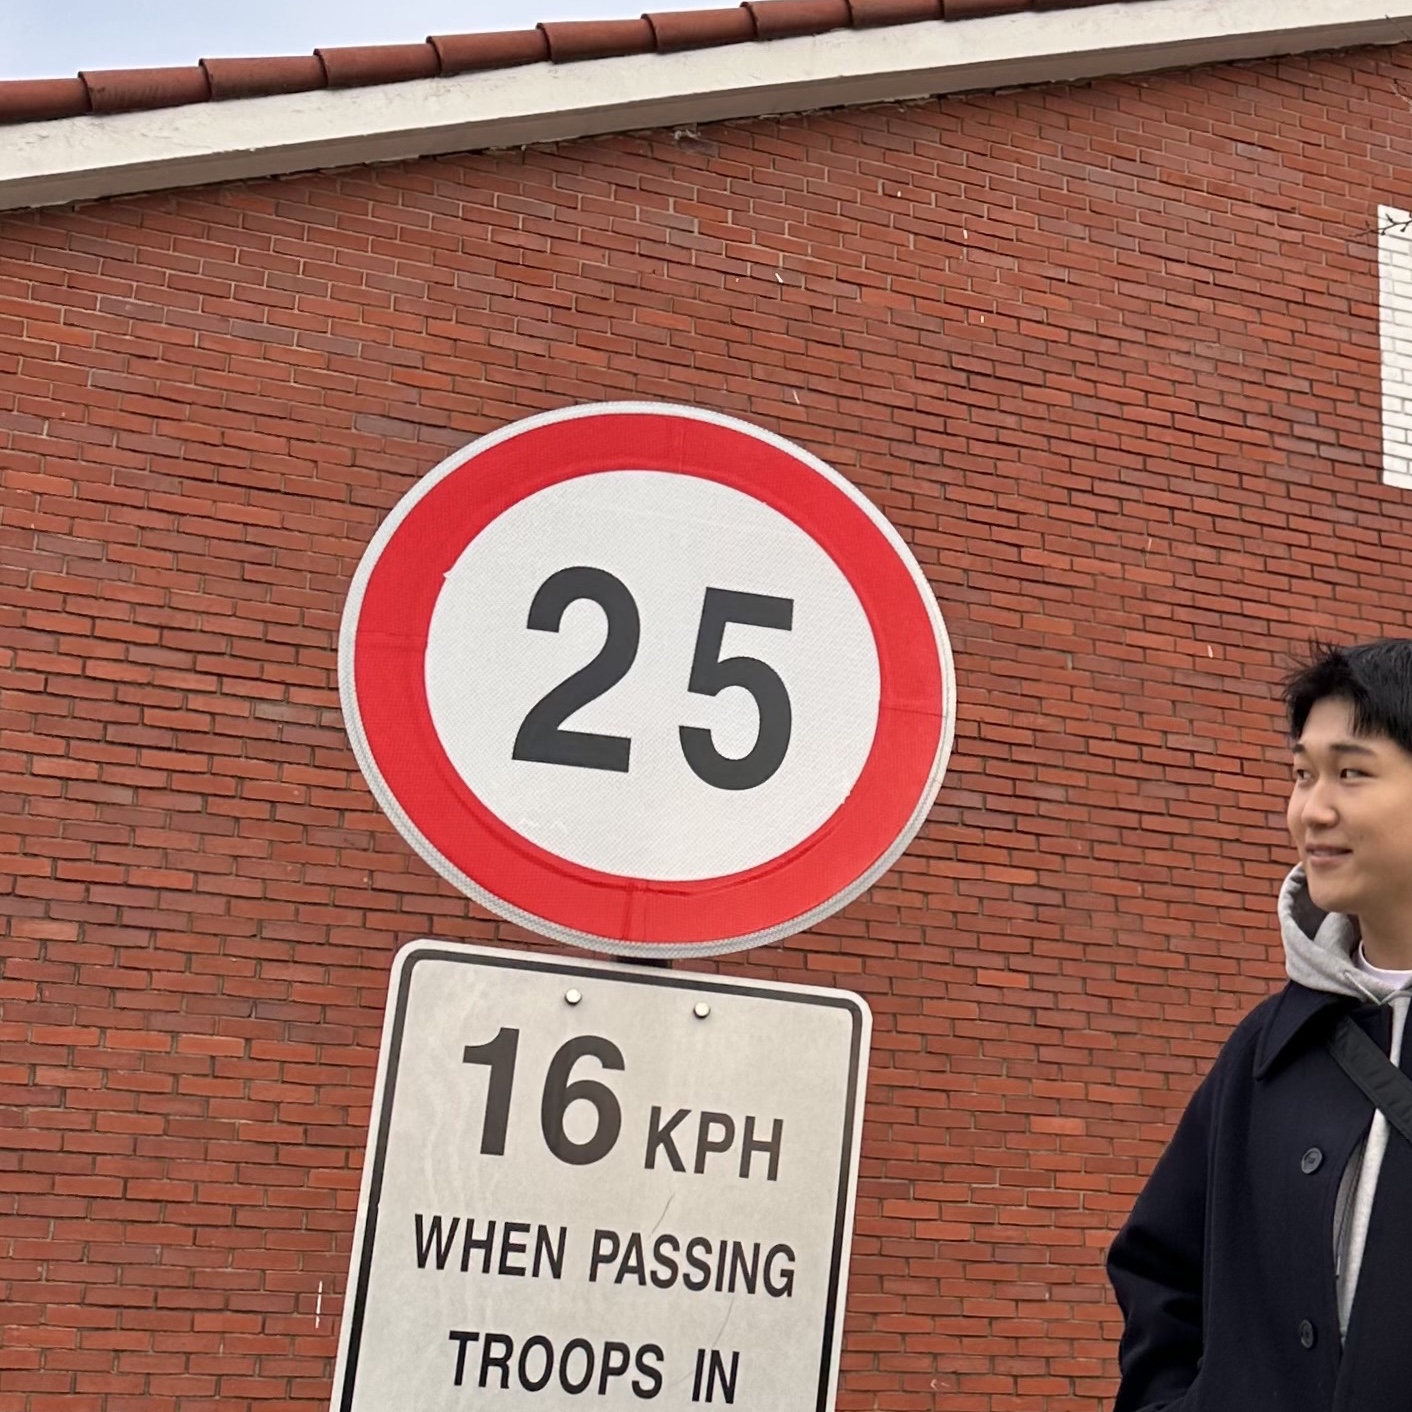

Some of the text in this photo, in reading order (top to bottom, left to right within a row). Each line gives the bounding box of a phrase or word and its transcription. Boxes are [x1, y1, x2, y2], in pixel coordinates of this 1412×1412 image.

[511, 565, 795, 792] 25
[462, 1026, 785, 1182] 16 KPH
[413, 1212, 796, 1299] WHEN PASSING
[448, 1329, 740, 1405] TROOPS IN
